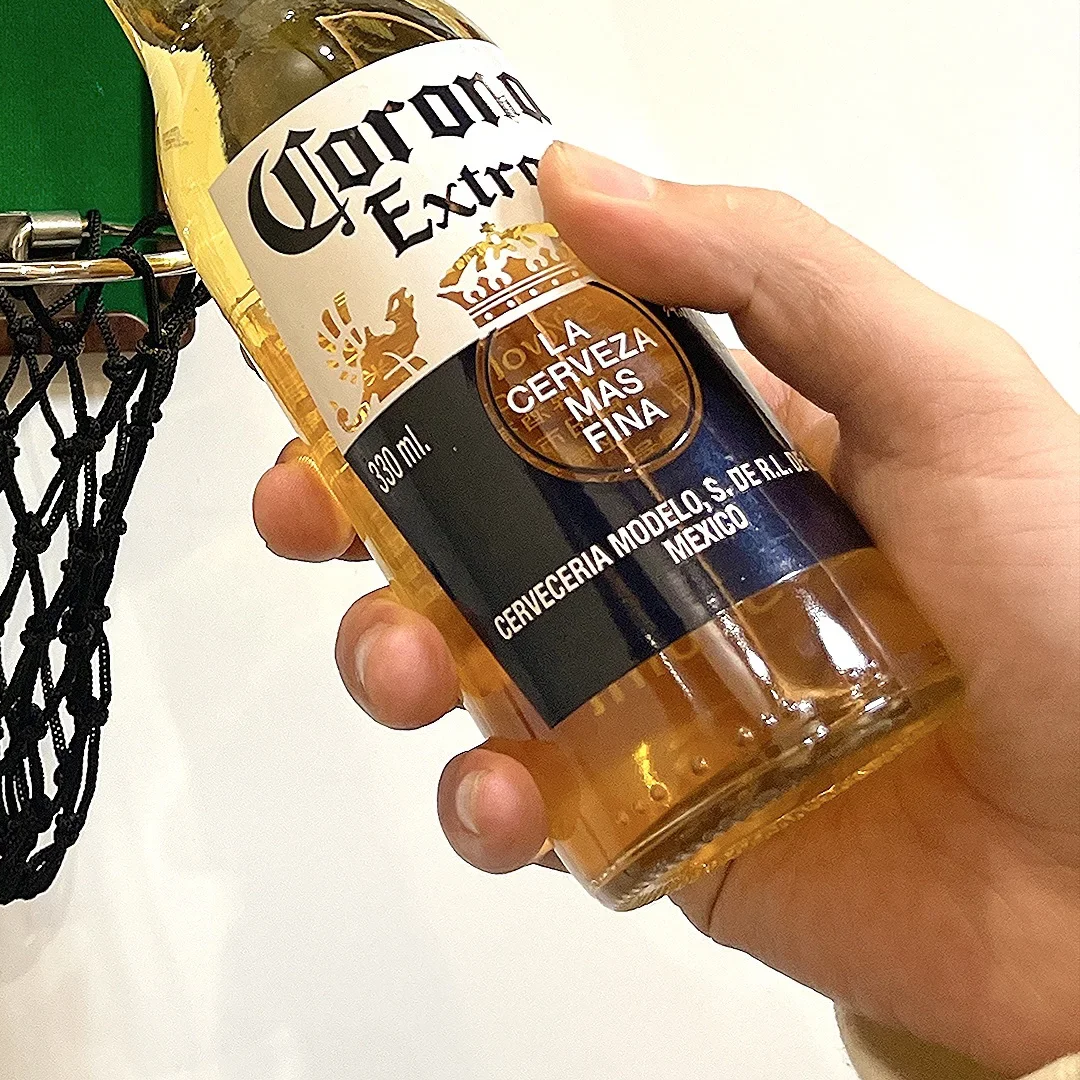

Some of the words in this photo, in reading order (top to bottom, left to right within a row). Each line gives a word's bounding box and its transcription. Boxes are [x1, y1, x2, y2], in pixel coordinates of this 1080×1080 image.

[247, 71, 553, 256] Corona
[537, 319, 592, 356] LA
[506, 327, 658, 414] CERVEZA
[563, 368, 645, 423] MAS
[582, 398, 669, 454] FINA
[368, 444, 404, 494] 330
[396, 424, 432, 468] ml.
[493, 544, 614, 640] CERVECERIA
[607, 489, 712, 558] MODELO,
[726, 462, 762, 493] DE
[661, 504, 749, 565] MEXICO
